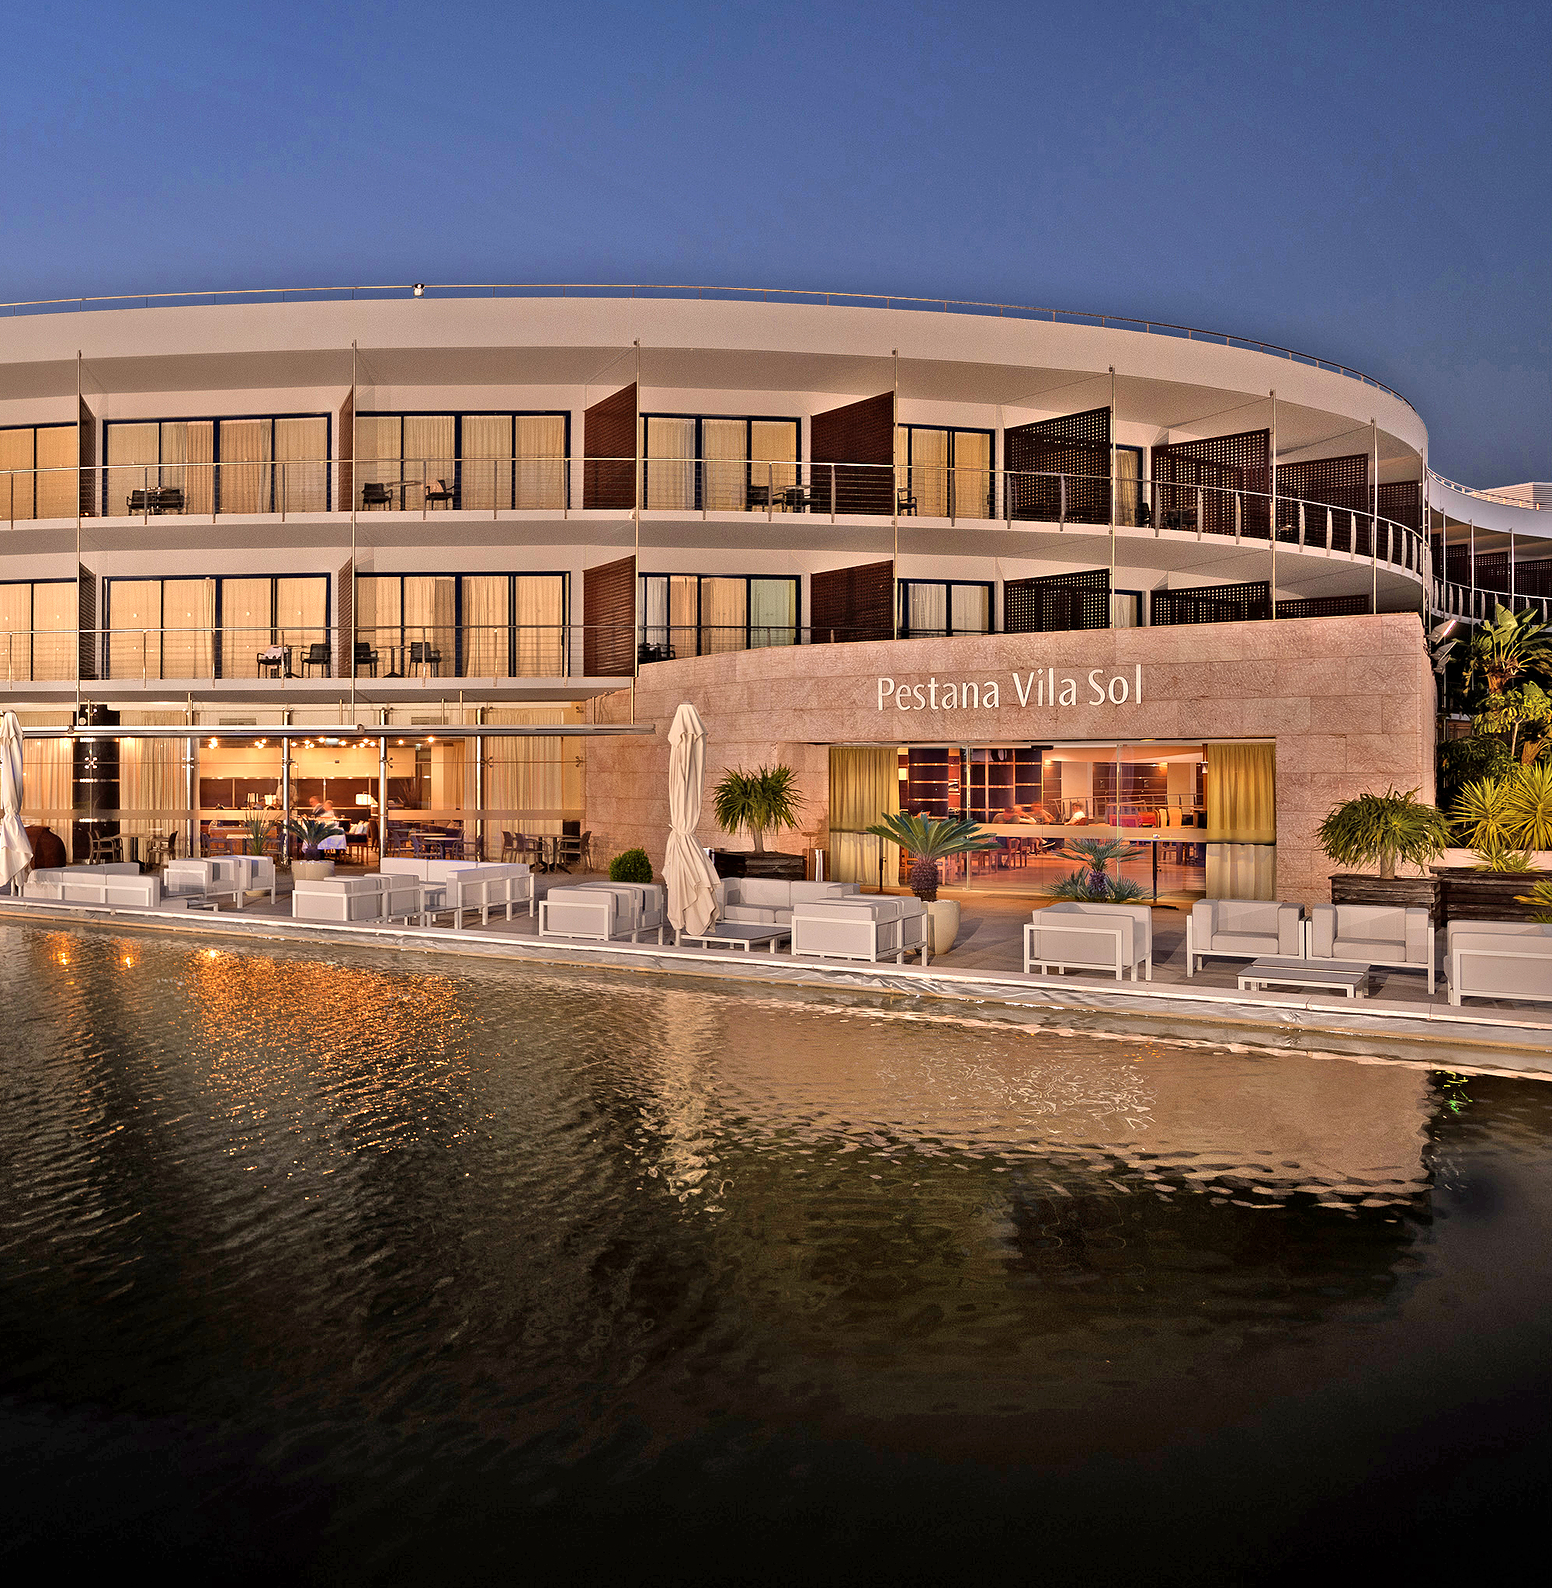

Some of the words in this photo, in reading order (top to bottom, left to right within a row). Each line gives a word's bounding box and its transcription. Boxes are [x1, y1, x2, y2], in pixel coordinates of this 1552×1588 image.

[877, 677, 1000, 711] Pestana
[1012, 667, 1077, 707] Vila
[1088, 663, 1142, 706] Sol
